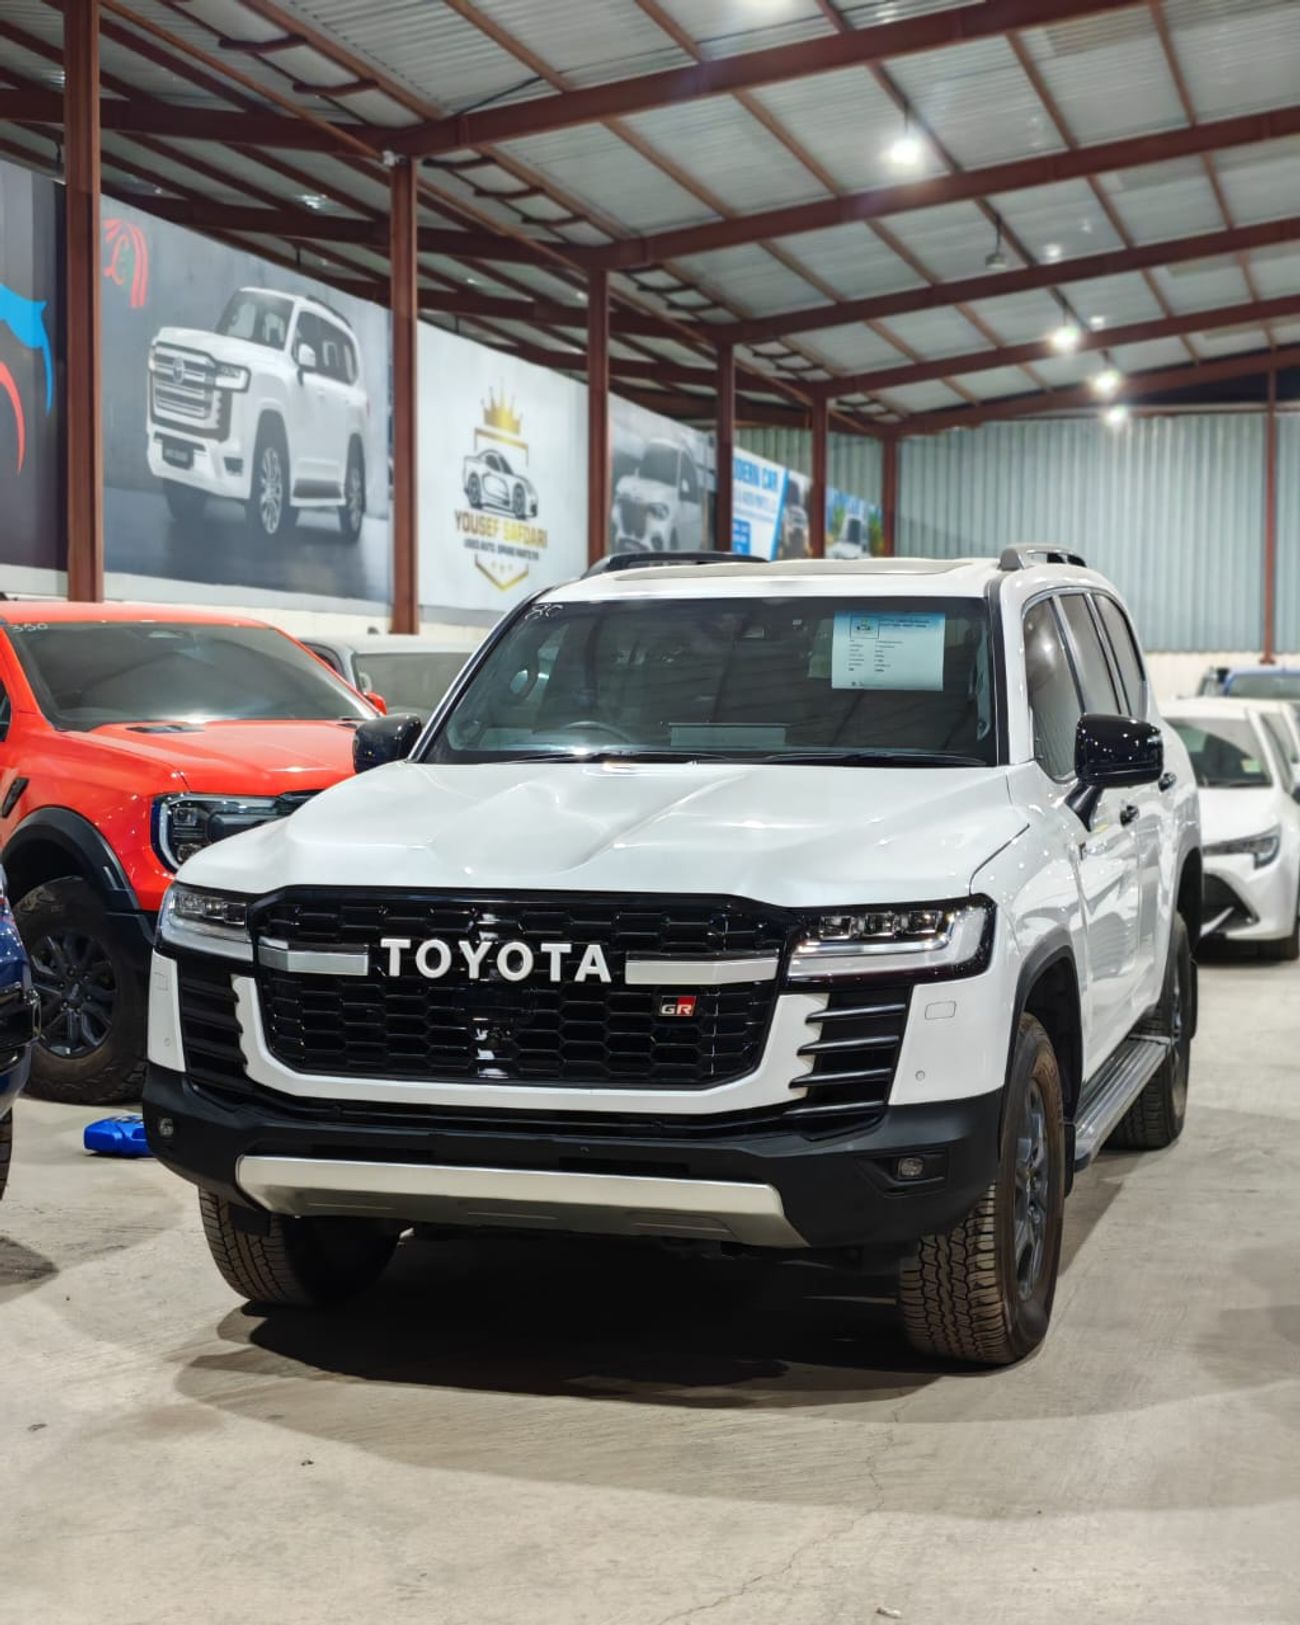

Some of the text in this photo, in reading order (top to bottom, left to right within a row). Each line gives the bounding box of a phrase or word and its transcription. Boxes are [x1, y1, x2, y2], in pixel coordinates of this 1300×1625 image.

[454, 510, 499, 537] YOUSEF
[380, 937, 612, 983] TOYOTA
[661, 1004, 692, 1015] GR
